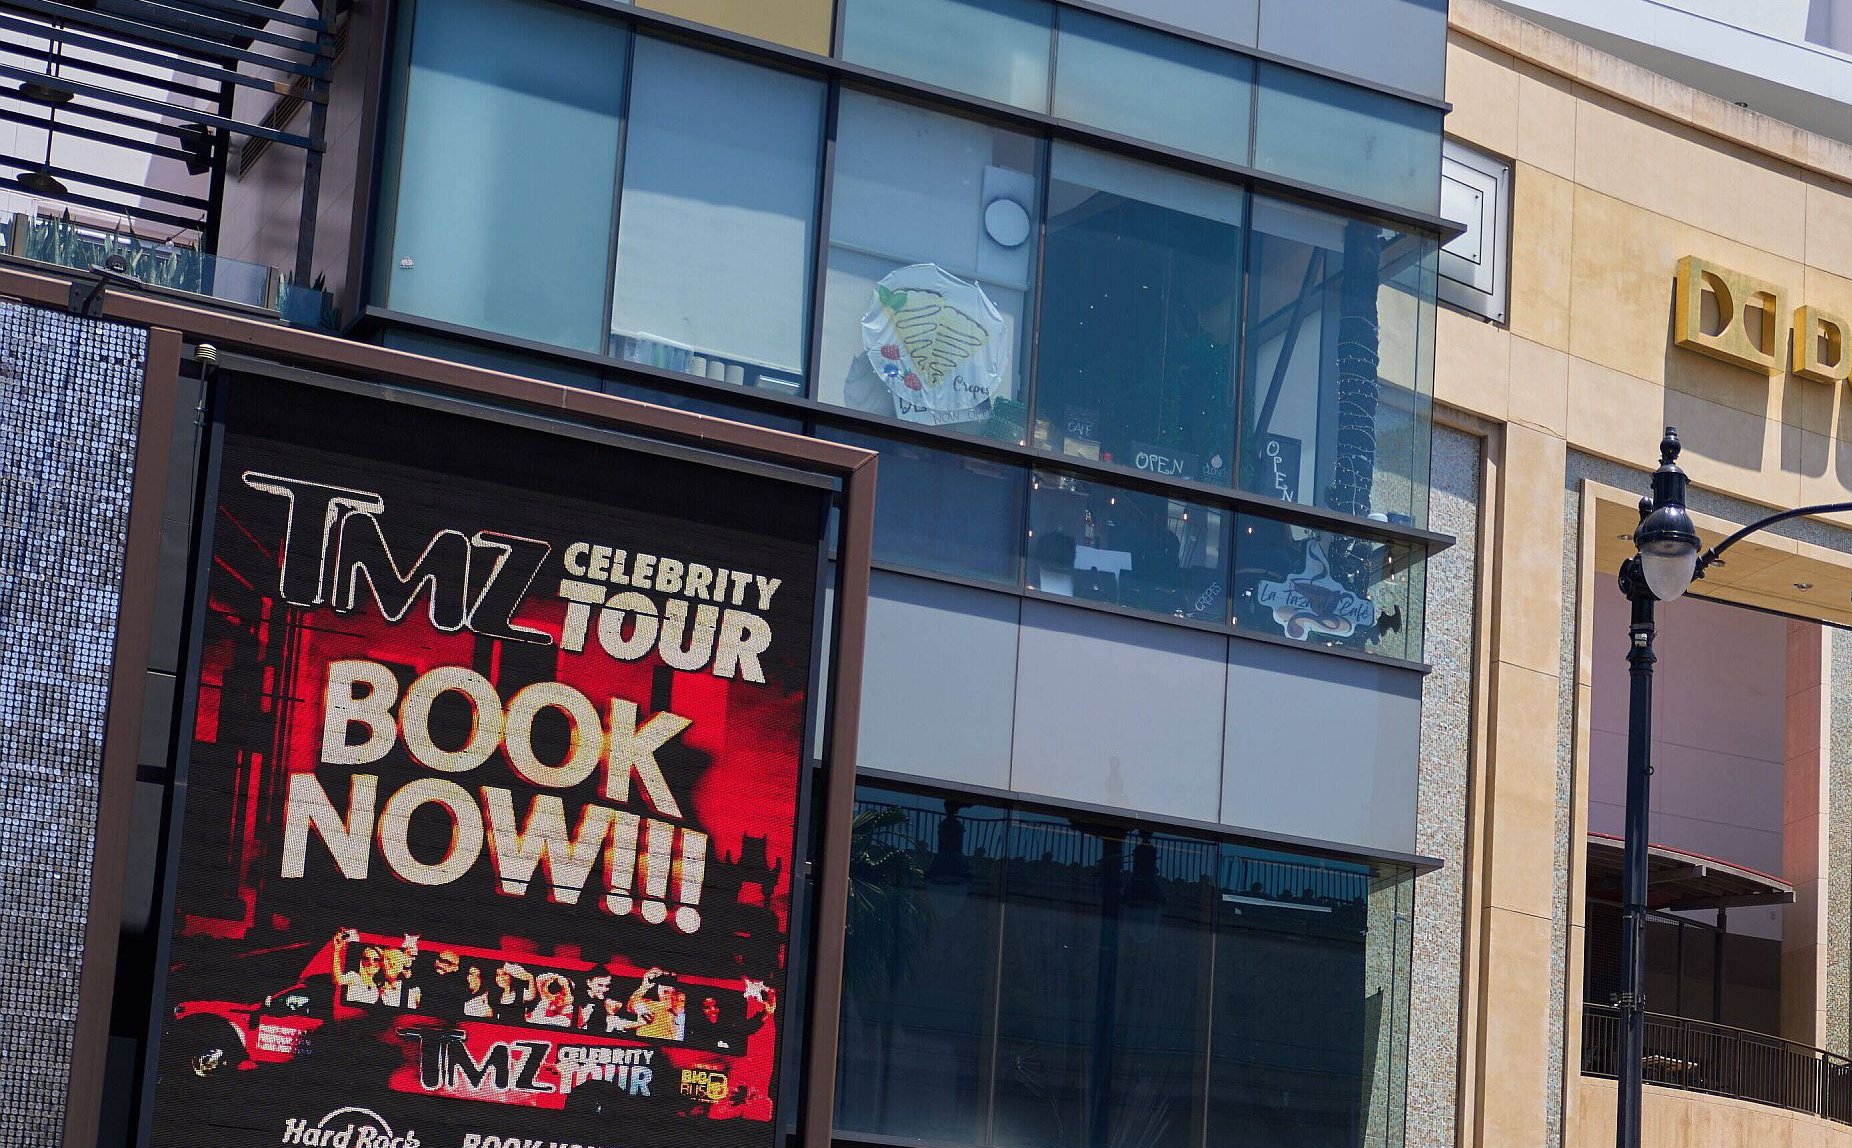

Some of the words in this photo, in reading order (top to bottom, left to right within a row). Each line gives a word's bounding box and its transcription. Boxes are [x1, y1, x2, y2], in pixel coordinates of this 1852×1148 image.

[1135, 452, 1185, 475] OPEN
[1266, 440, 1294, 502] OPEN
[242, 470, 553, 646] TMZ
[564, 541, 782, 611] CELEBRITY
[559, 578, 772, 684] TOUR
[320, 659, 695, 820] BOOK
[280, 772, 709, 935] NOW!!!
[396, 1026, 557, 1092] TMZ
[557, 1045, 655, 1067] CELEBRITY
